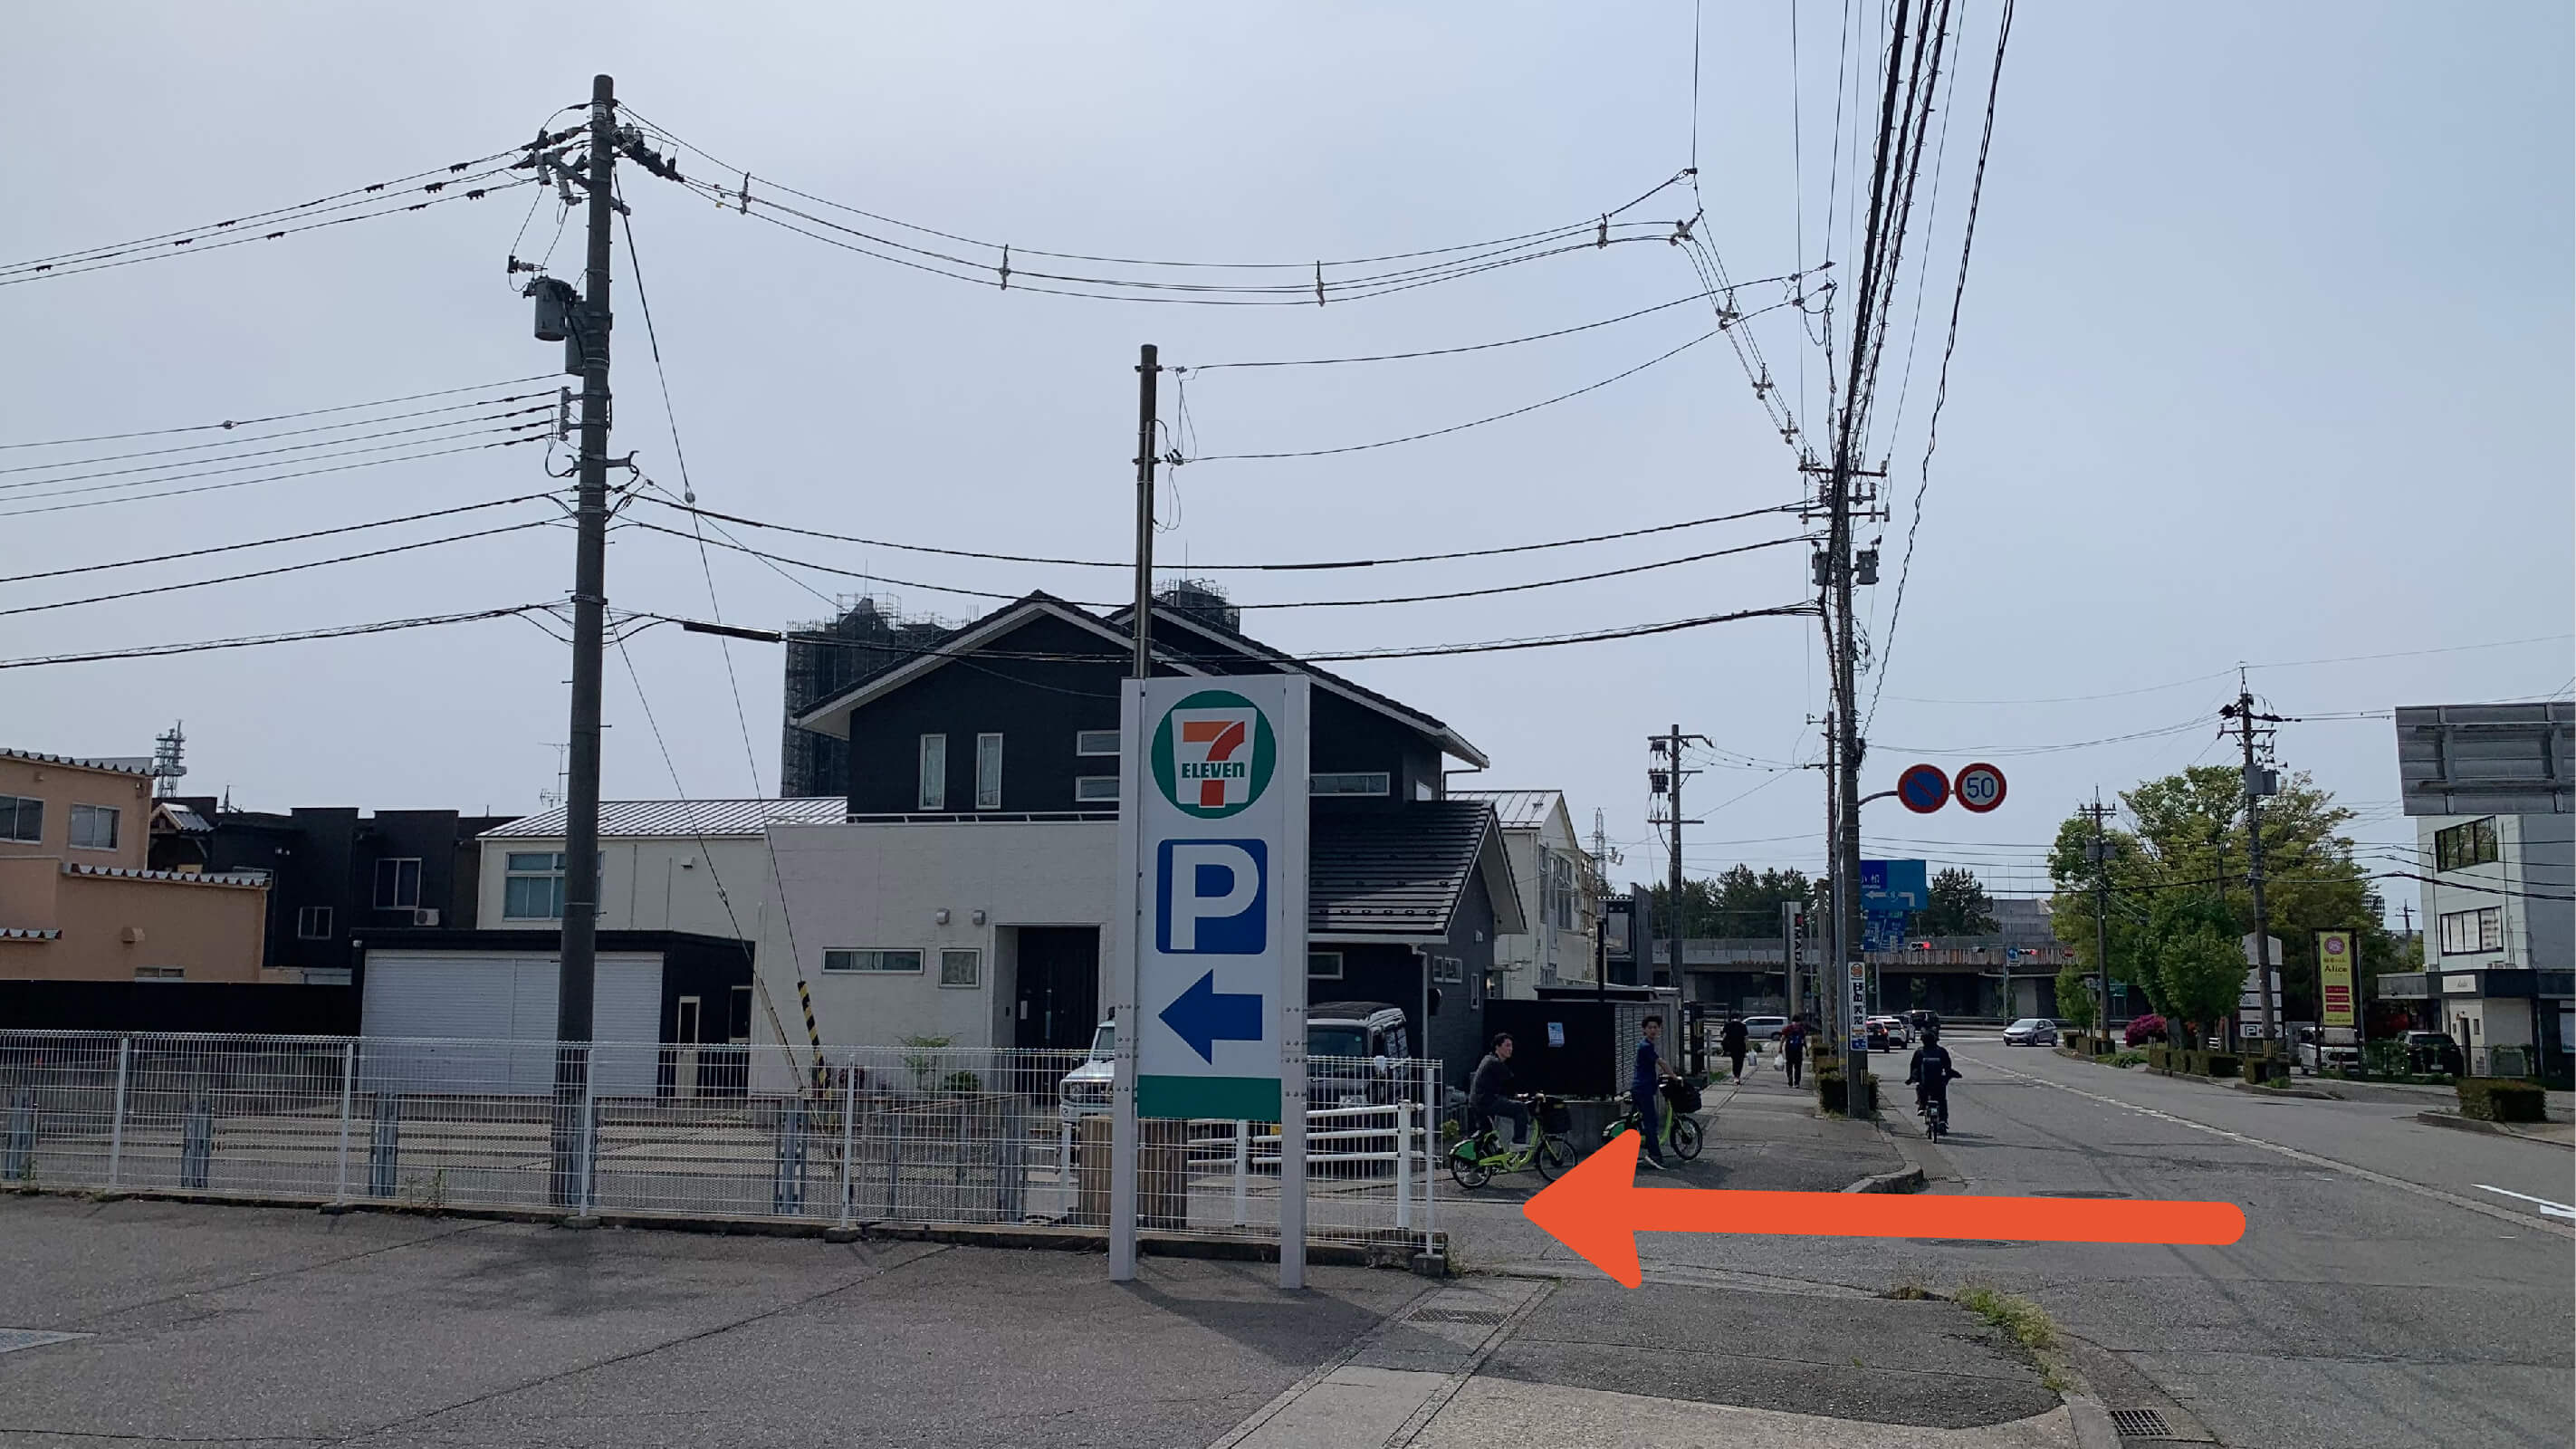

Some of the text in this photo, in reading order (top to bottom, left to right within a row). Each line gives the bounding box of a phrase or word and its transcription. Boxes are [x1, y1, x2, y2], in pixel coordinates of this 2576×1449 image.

[1182, 721, 1245, 806] 7
[1966, 776, 1996, 799] 50
[1170, 843, 1259, 950] P
[2324, 964, 2348, 973] Alice
